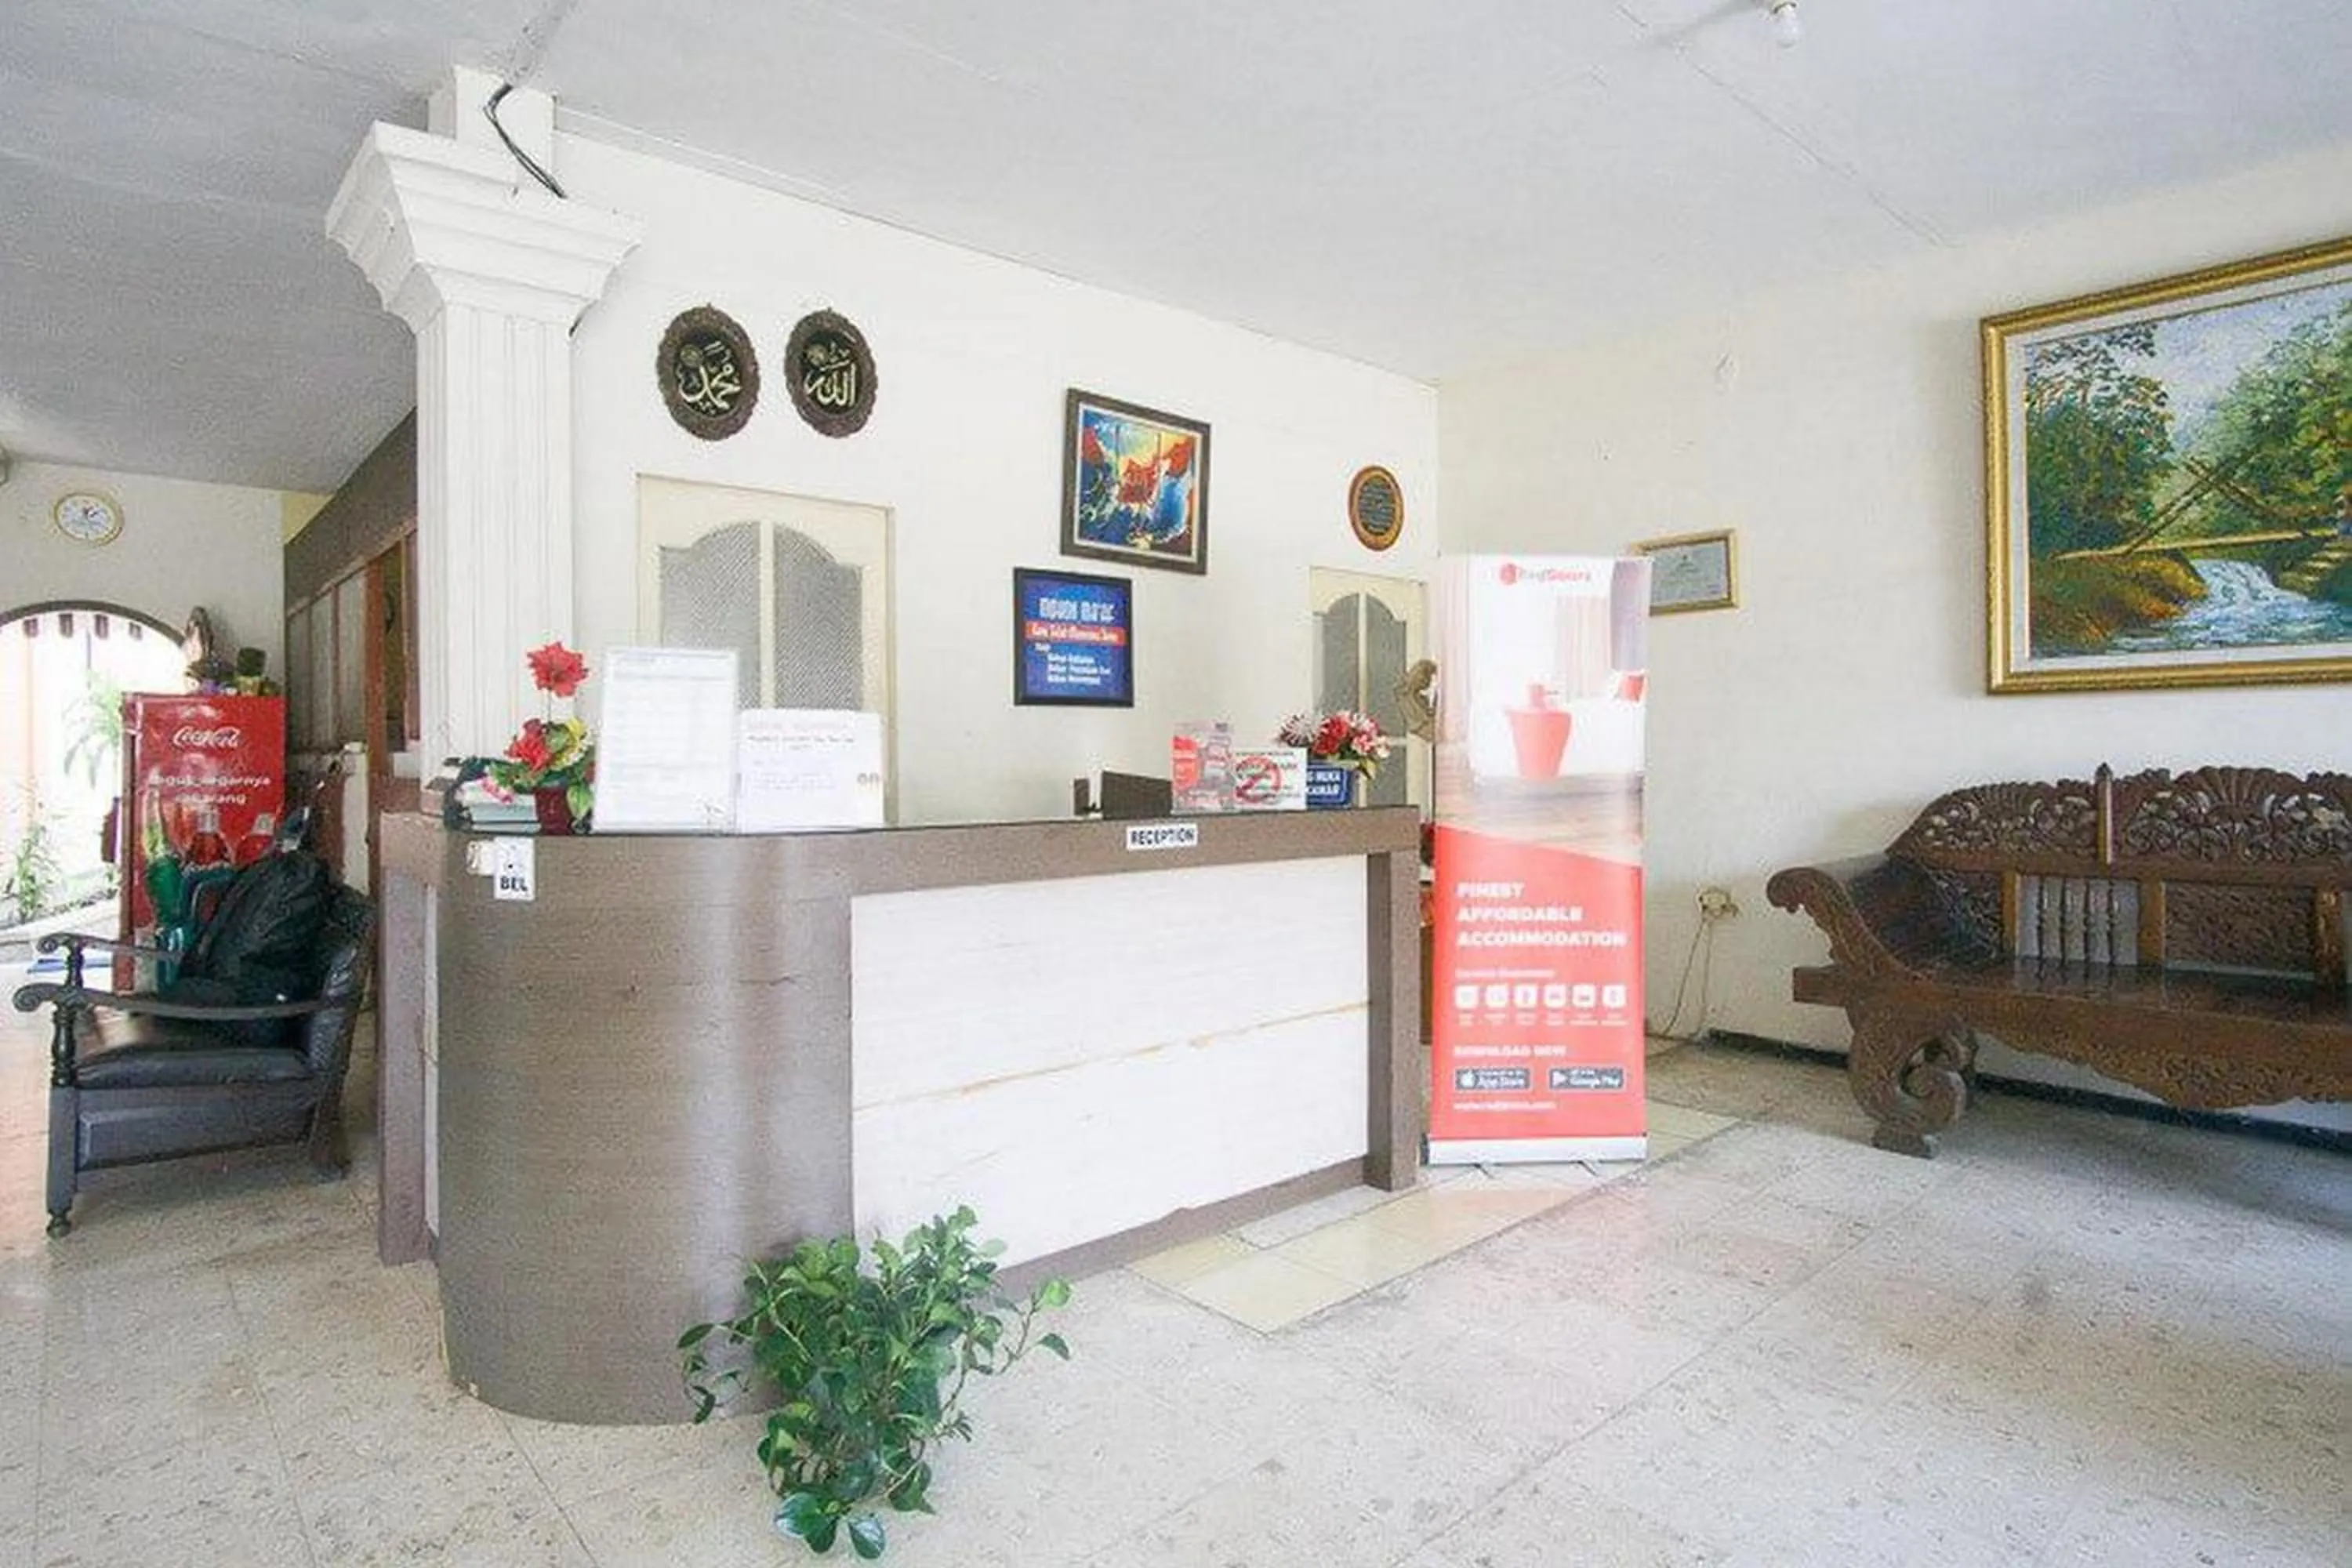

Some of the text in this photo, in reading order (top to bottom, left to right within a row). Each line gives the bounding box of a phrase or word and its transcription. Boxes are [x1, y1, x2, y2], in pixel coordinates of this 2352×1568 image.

[1131, 827, 1195, 845] RECEPTION
[500, 876, 528, 892] BEL
[1456, 881, 1525, 898] FINEST
[1456, 906, 1584, 923] AFFORDABLE
[1457, 930, 1628, 948] ACCOMMODATION
